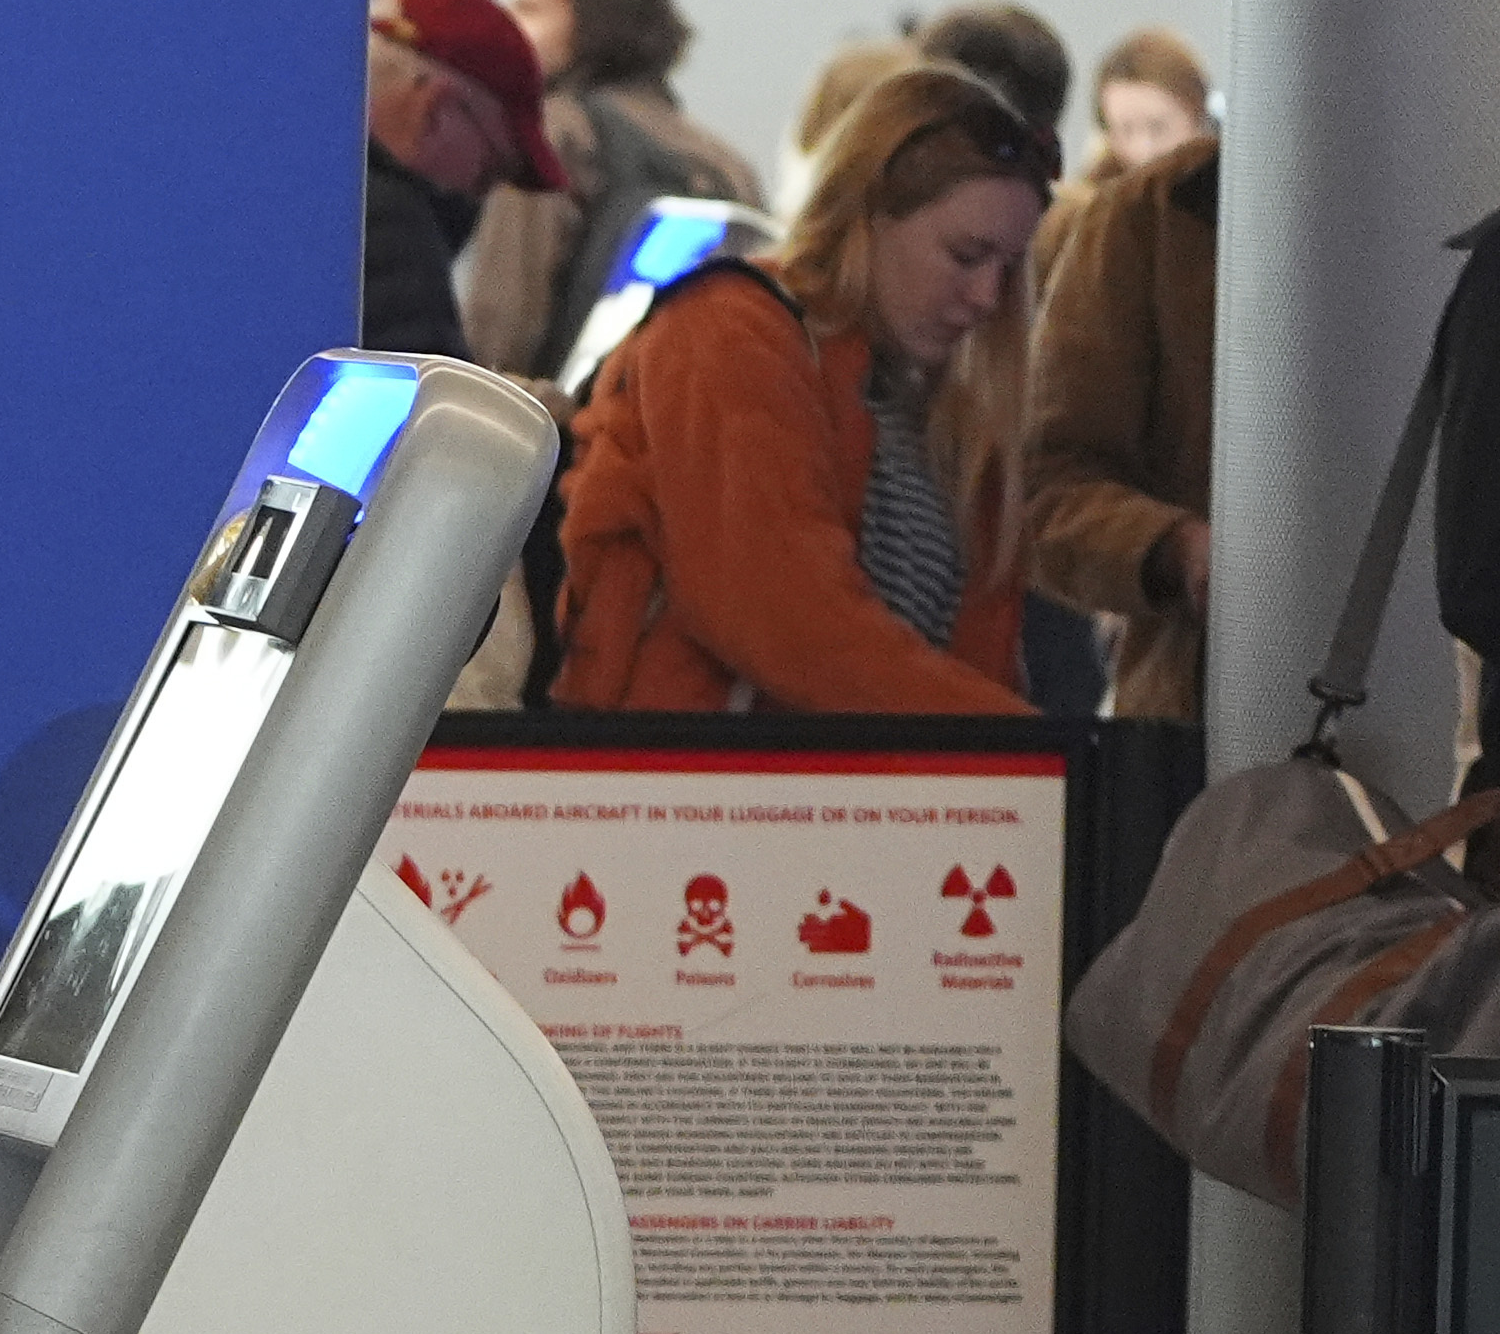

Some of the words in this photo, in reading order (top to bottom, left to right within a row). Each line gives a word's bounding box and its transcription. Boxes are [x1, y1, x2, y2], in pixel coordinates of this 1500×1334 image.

[469, 803, 548, 819] ABOARD
[554, 804, 642, 821] AIRCRAFT
[648, 805, 667, 821] IN
[673, 805, 724, 821] YOUR
[730, 805, 814, 822] LUGGAGE
[888, 806, 938, 823] YOUR
[933, 951, 1024, 968] Radioactive
[822, 1216, 896, 1231] LIABILITY
